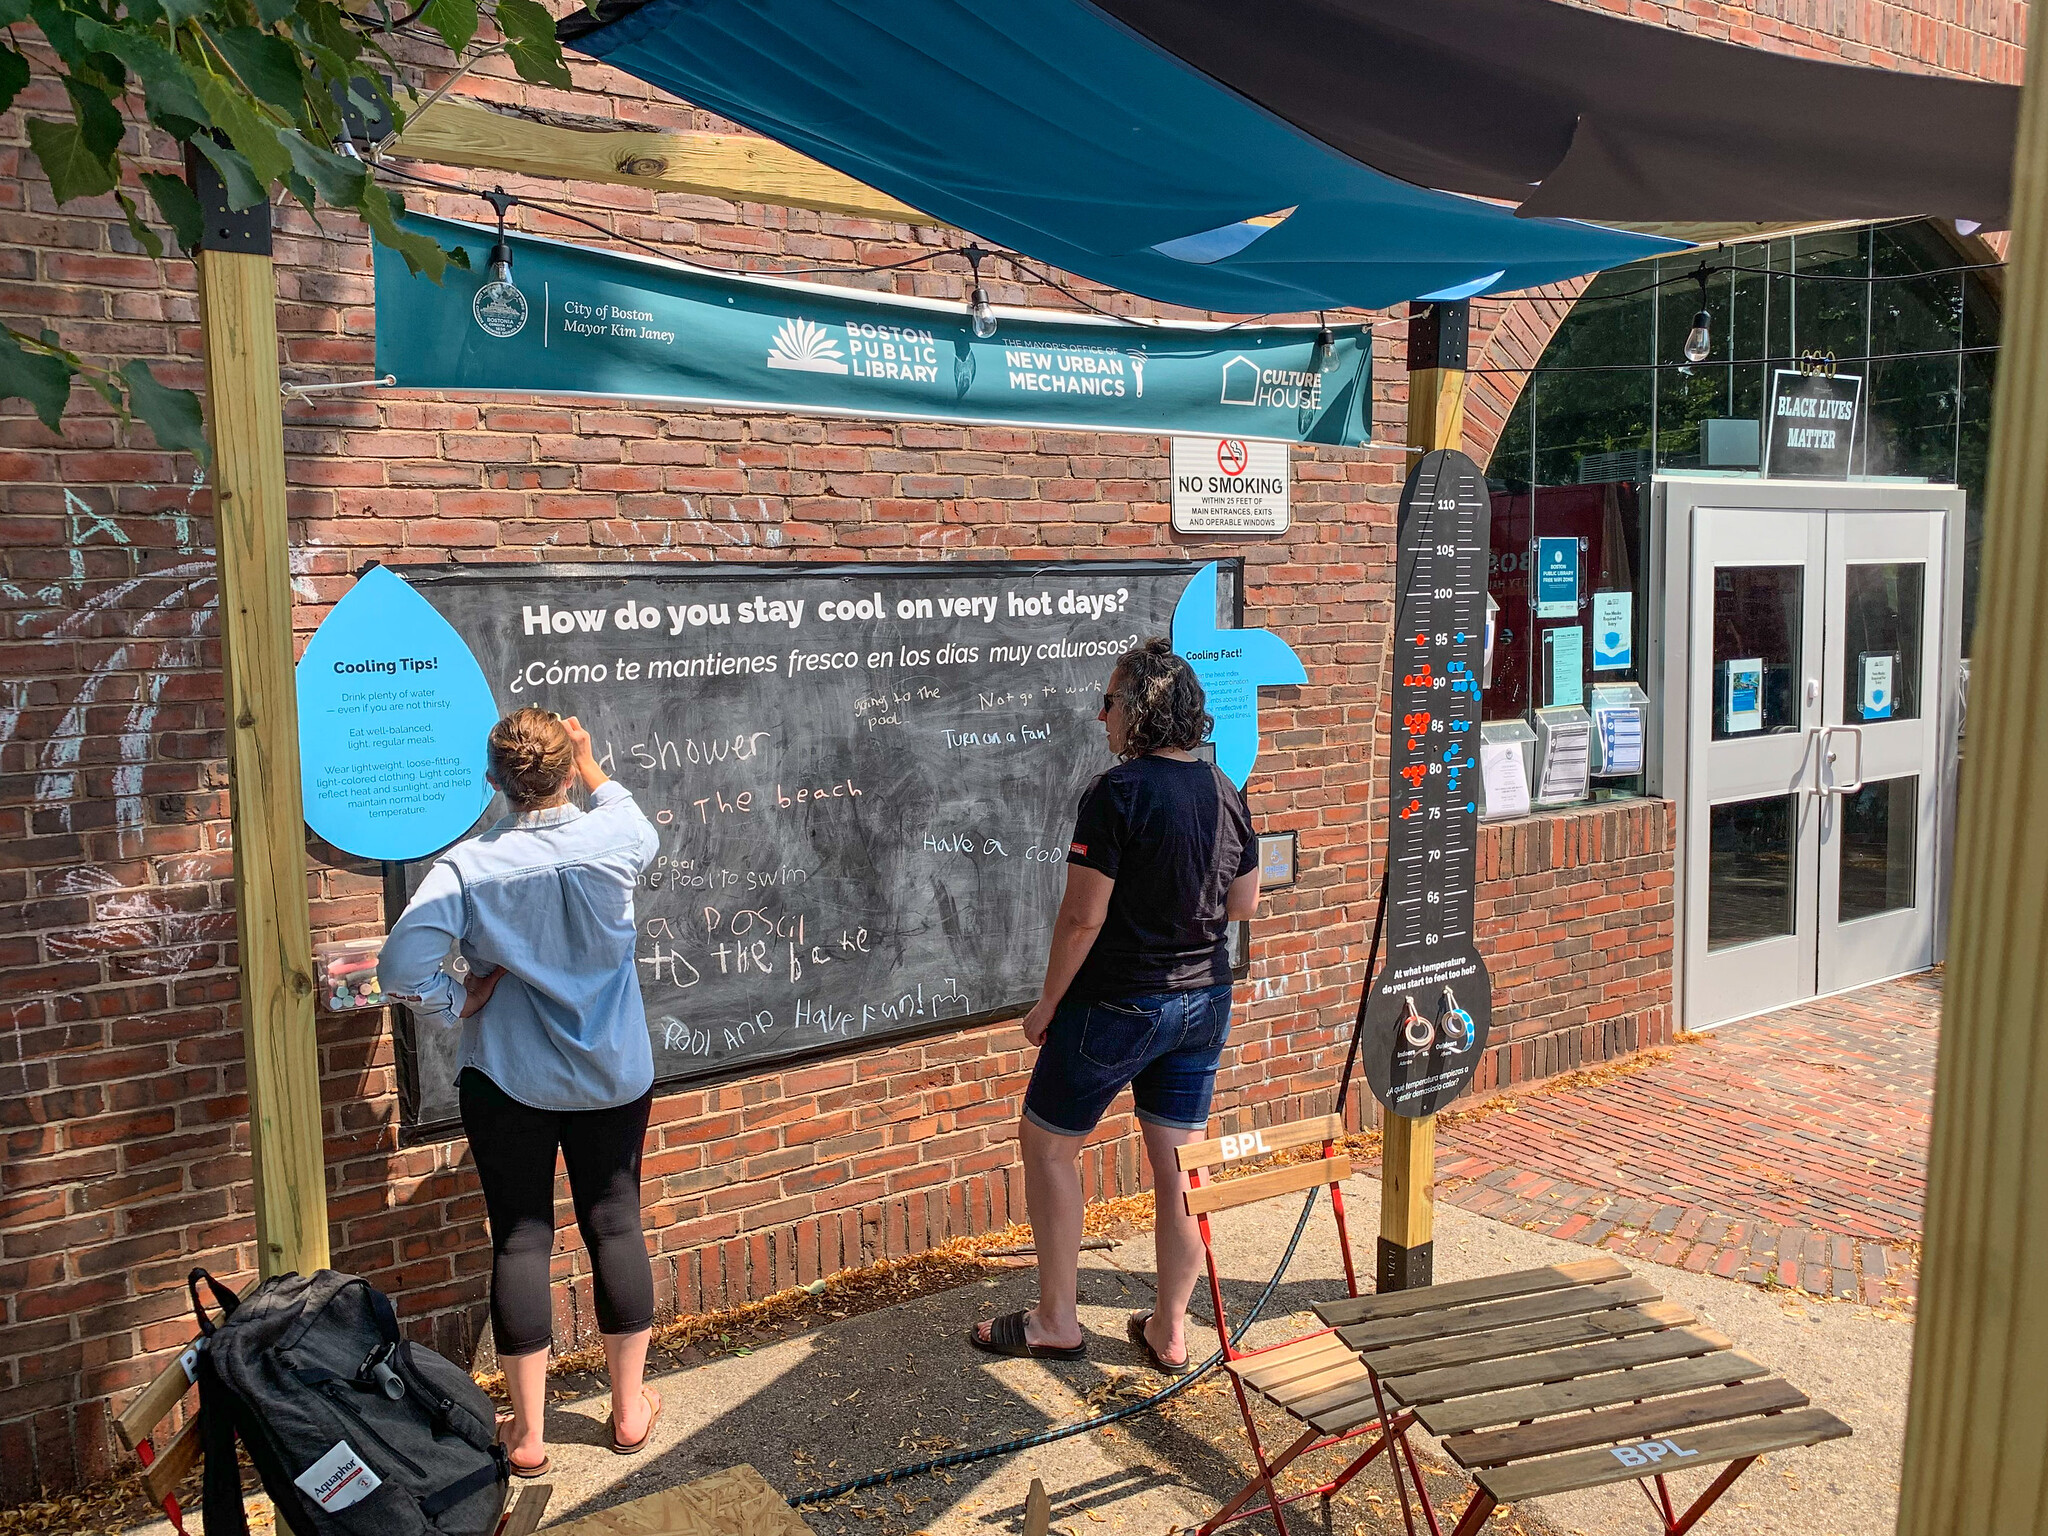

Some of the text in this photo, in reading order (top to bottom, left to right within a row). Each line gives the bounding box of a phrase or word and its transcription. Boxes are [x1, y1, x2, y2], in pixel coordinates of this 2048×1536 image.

[564, 301, 654, 322] City of Boston
[564, 319, 675, 344] Mayor Kim Janey
[845, 321, 935, 345] BOSTON
[850, 340, 937, 364] PUBLIC
[1002, 338, 1119, 355] THE MAYOR'S OFFICE OF
[852, 359, 939, 383] LIBRARY
[1005, 351, 1124, 375] NEW URBAN
[1009, 372, 1126, 397] MECHANICS
[1262, 369, 1322, 388] CULTURE
[1258, 387, 1322, 410] HOUSE
[1777, 396, 1853, 420] BLACK LIVES
[1787, 428, 1836, 449] MATTER
[1179, 476, 1283, 494] NO SMOKING
[1201, 497, 1225, 505] WITHIN
[1226, 497, 1235, 505] 25
[1236, 497, 1252, 505] FEET
[1437, 500, 1455, 511] 110
[1189, 518, 1204, 526] AND
[1205, 518, 1242, 526] OPERABLE
[1210, 508, 1253, 516] ENTRANCES,
[1436, 545, 1455, 557] 105
[1434, 588, 1453, 599] 100
[522, 587, 1129, 636] How do you stay cool on very hot days?
[1435, 633, 1448, 645] 95
[509, 634, 1138, 694] ¿Cómo te mantienes fresco en los días muy calurosos?
[1186, 648, 1243, 661] Cooling Fact!
[333, 656, 438, 675] Cooling Tips!
[1433, 676, 1446, 689] 90
[341, 689, 435, 702] Drink plenty of water
[853, 685, 941, 717] going to the
[979, 692, 1014, 711] Not
[1020, 692, 1033, 707] go
[1042, 686, 1057, 697] to
[337, 705, 361, 714] even
[362, 704, 369, 712] if
[369, 705, 388, 714] you
[389, 703, 404, 711] are
[405, 701, 421, 710] not
[349, 728, 365, 738] Eat
[1431, 719, 1444, 733] 85
[372, 736, 405, 748] regular
[407, 735, 437, 745] meals.
[983, 732, 1002, 744] on
[1006, 733, 1017, 743] a
[631, 731, 771, 771] shower
[316, 774, 377, 789] light-colored
[419, 769, 442, 780] Light
[444, 768, 472, 777] colors
[324, 765, 349, 775] Wear
[1429, 763, 1442, 775] 80
[318, 789, 349, 800] reflect
[350, 787, 371, 796] heat
[373, 785, 391, 795] and
[432, 780, 450, 789] and
[451, 778, 472, 789] help
[347, 792, 447, 809] maintain normal body
[693, 779, 862, 824] The beach
[1428, 807, 1441, 820] 75
[983, 838, 1008, 857] a
[1428, 850, 1441, 863] 70
[722, 869, 739, 889] to
[747, 864, 806, 891] swim
[1427, 891, 1440, 904] 65
[646, 917, 675, 940] a
[1425, 933, 1438, 945] 60
[710, 940, 773, 974] the
[1394, 957, 1466, 979] At what temperature
[1382, 965, 1476, 995] do you start to feel too hot?
[795, 998, 856, 1036] Have
[1220, 1131, 1271, 1160] BPL
[1610, 1439, 1699, 1467] BPL
[314, 1459, 356, 1498] Aquaphor
